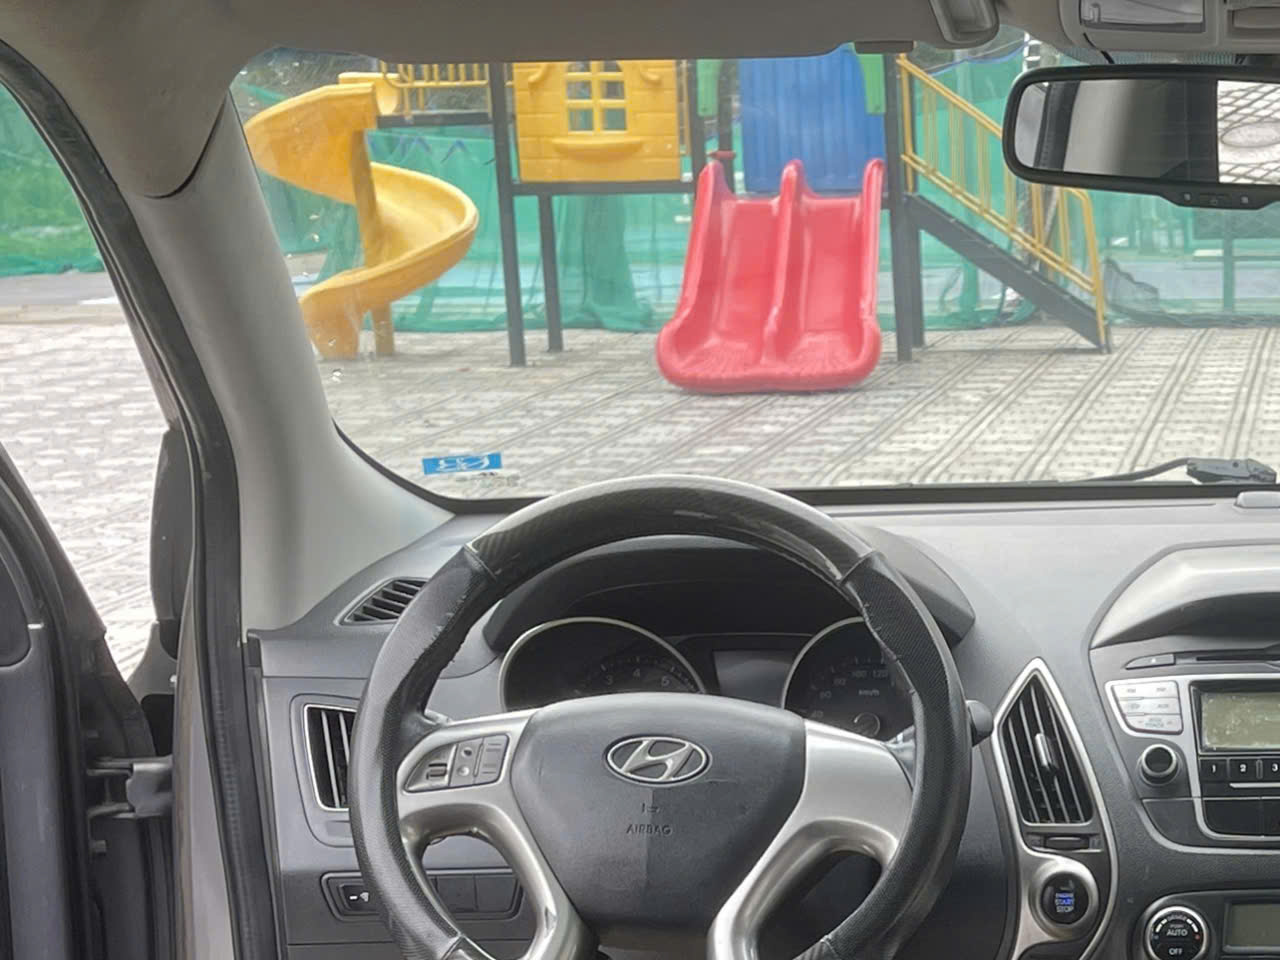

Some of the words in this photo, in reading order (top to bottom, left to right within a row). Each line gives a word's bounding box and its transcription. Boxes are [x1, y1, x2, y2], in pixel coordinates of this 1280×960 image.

[1211, 764, 1216, 773] 1
[1239, 764, 1247, 773] 2
[1271, 763, 1279, 772] 3
[626, 824, 672, 835] AIRBAG
[1166, 929, 1188, 937] AUTO
[1168, 947, 1183, 955] OFF
